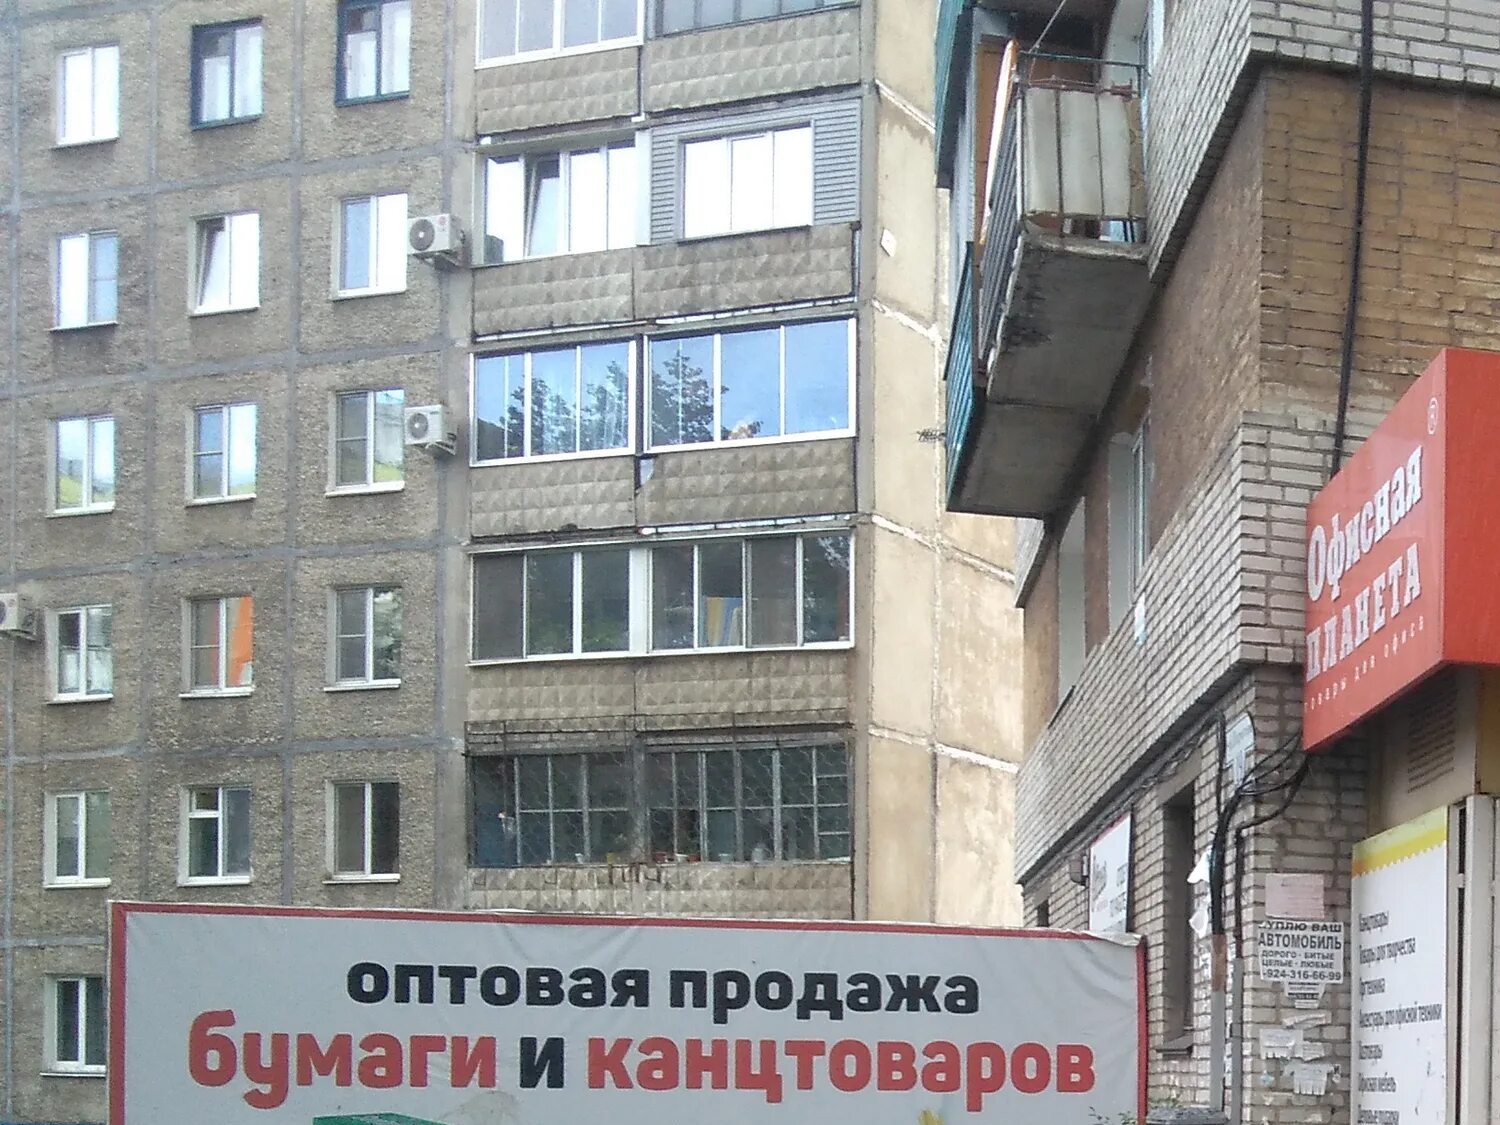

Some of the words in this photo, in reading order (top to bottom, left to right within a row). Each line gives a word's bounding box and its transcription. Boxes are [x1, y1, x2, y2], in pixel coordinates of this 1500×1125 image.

[1308, 445, 1423, 600] Офисная
[1306, 543, 1422, 682] ПЛАНЕТА
[1258, 932, 1342, 950] АВТОМОБИЛЬ
[1311, 923, 1342, 933] ВАШ
[346, 960, 648, 1009] оптовая
[669, 966, 979, 1023] продажа
[187, 1009, 497, 1108] бумаги
[519, 1036, 564, 1089] и
[588, 1032, 1095, 1111] канцтоваров
